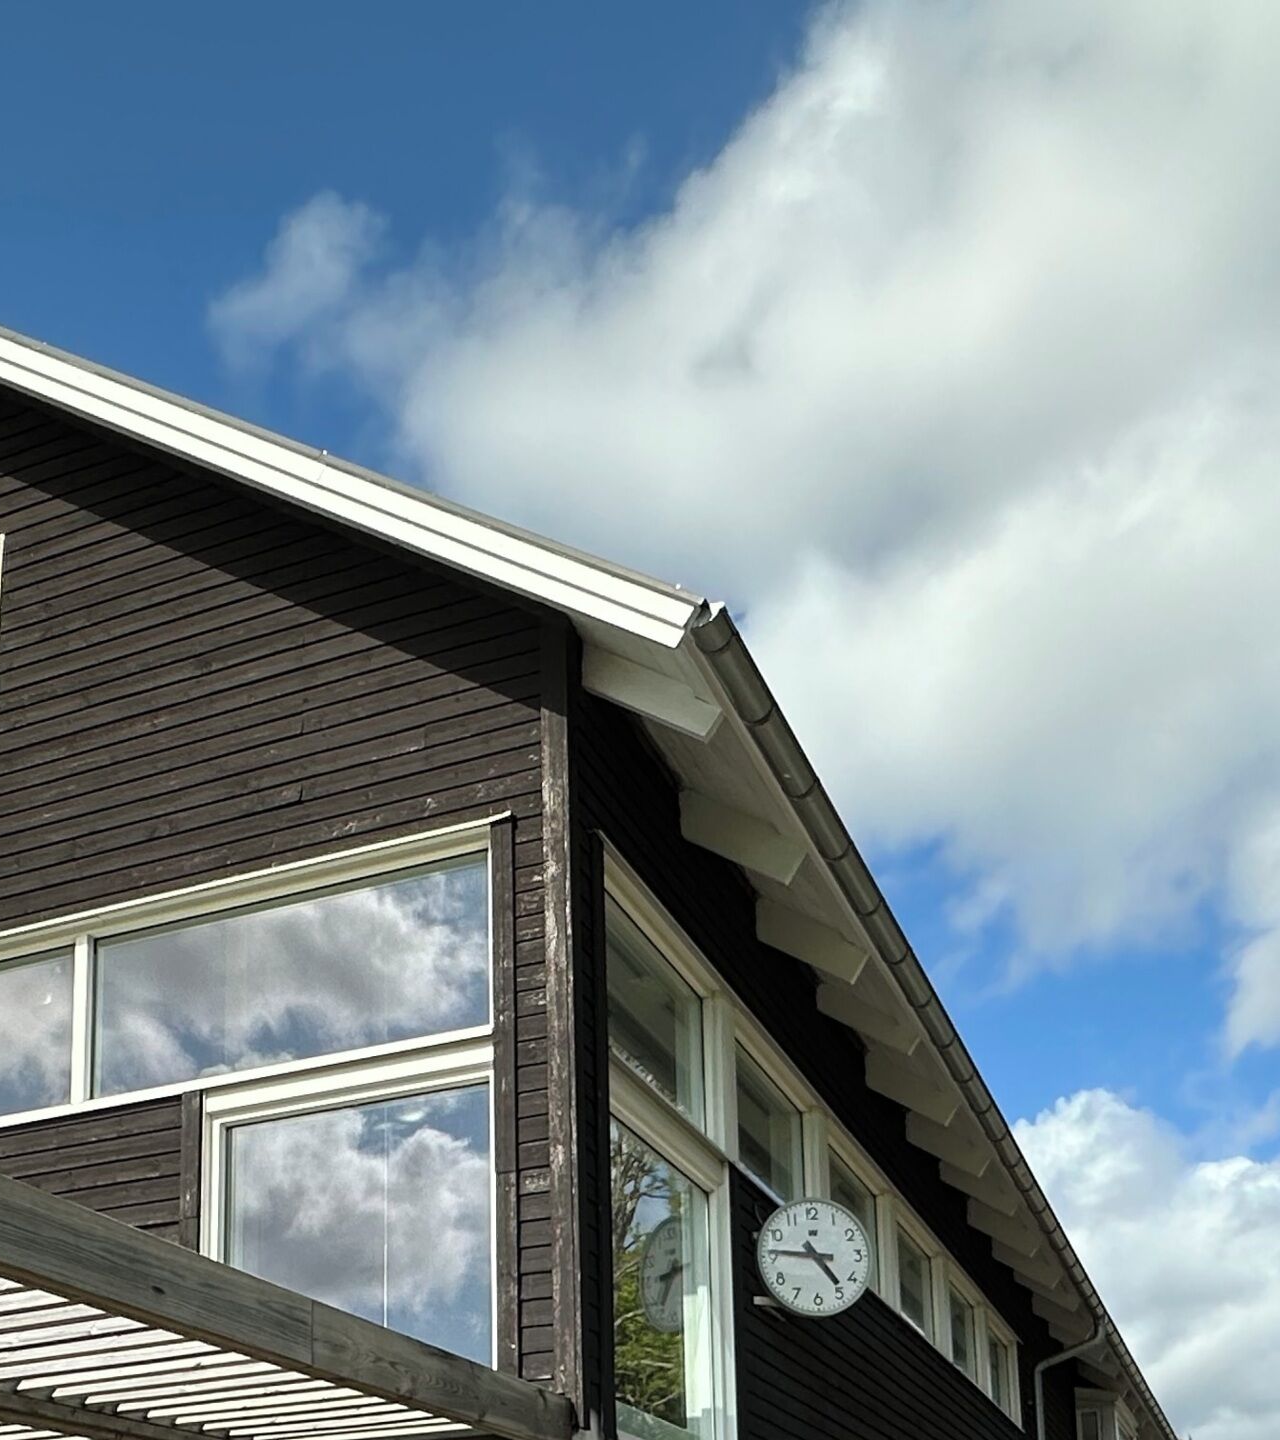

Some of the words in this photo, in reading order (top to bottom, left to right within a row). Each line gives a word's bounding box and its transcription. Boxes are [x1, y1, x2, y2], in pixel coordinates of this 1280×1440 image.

[786, 1213, 797, 1227] 11
[805, 1207, 818, 1221] 12
[769, 1229, 783, 1241] 10
[844, 1228, 855, 1241] 2
[768, 1251, 778, 1264] 9
[853, 1249, 863, 1262] 3
[775, 1272, 785, 1286] 8
[847, 1271, 858, 1283] 4
[792, 1287, 802, 1300] 7
[813, 1292, 823, 1306] 6
[835, 1286, 844, 1300] 5
